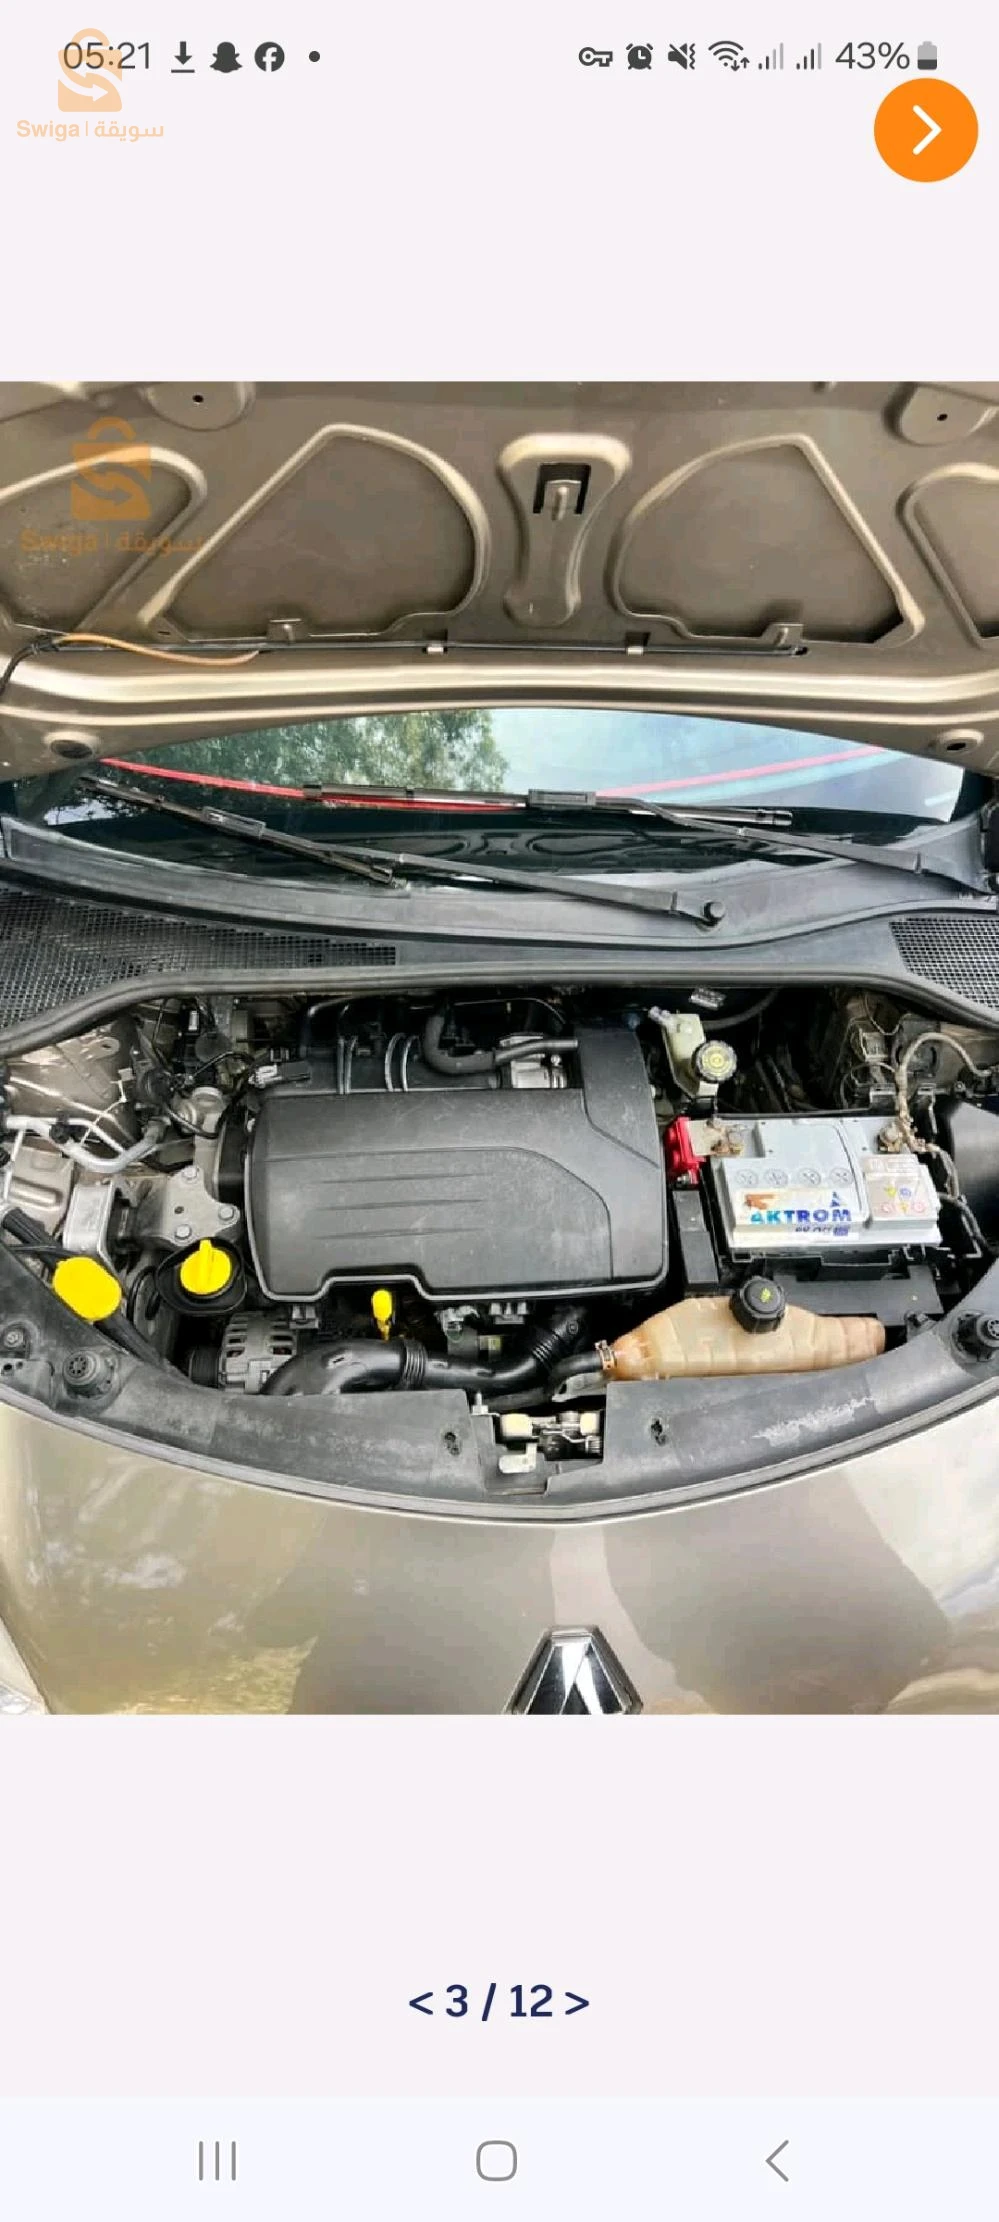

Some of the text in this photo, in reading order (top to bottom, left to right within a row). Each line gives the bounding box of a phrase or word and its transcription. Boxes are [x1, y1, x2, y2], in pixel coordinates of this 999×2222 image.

[63, 41, 150, 69] 05:21
[835, 41, 911, 70] 43%
[445, 1984, 468, 2018] 3
[510, 1984, 553, 2018] 12
